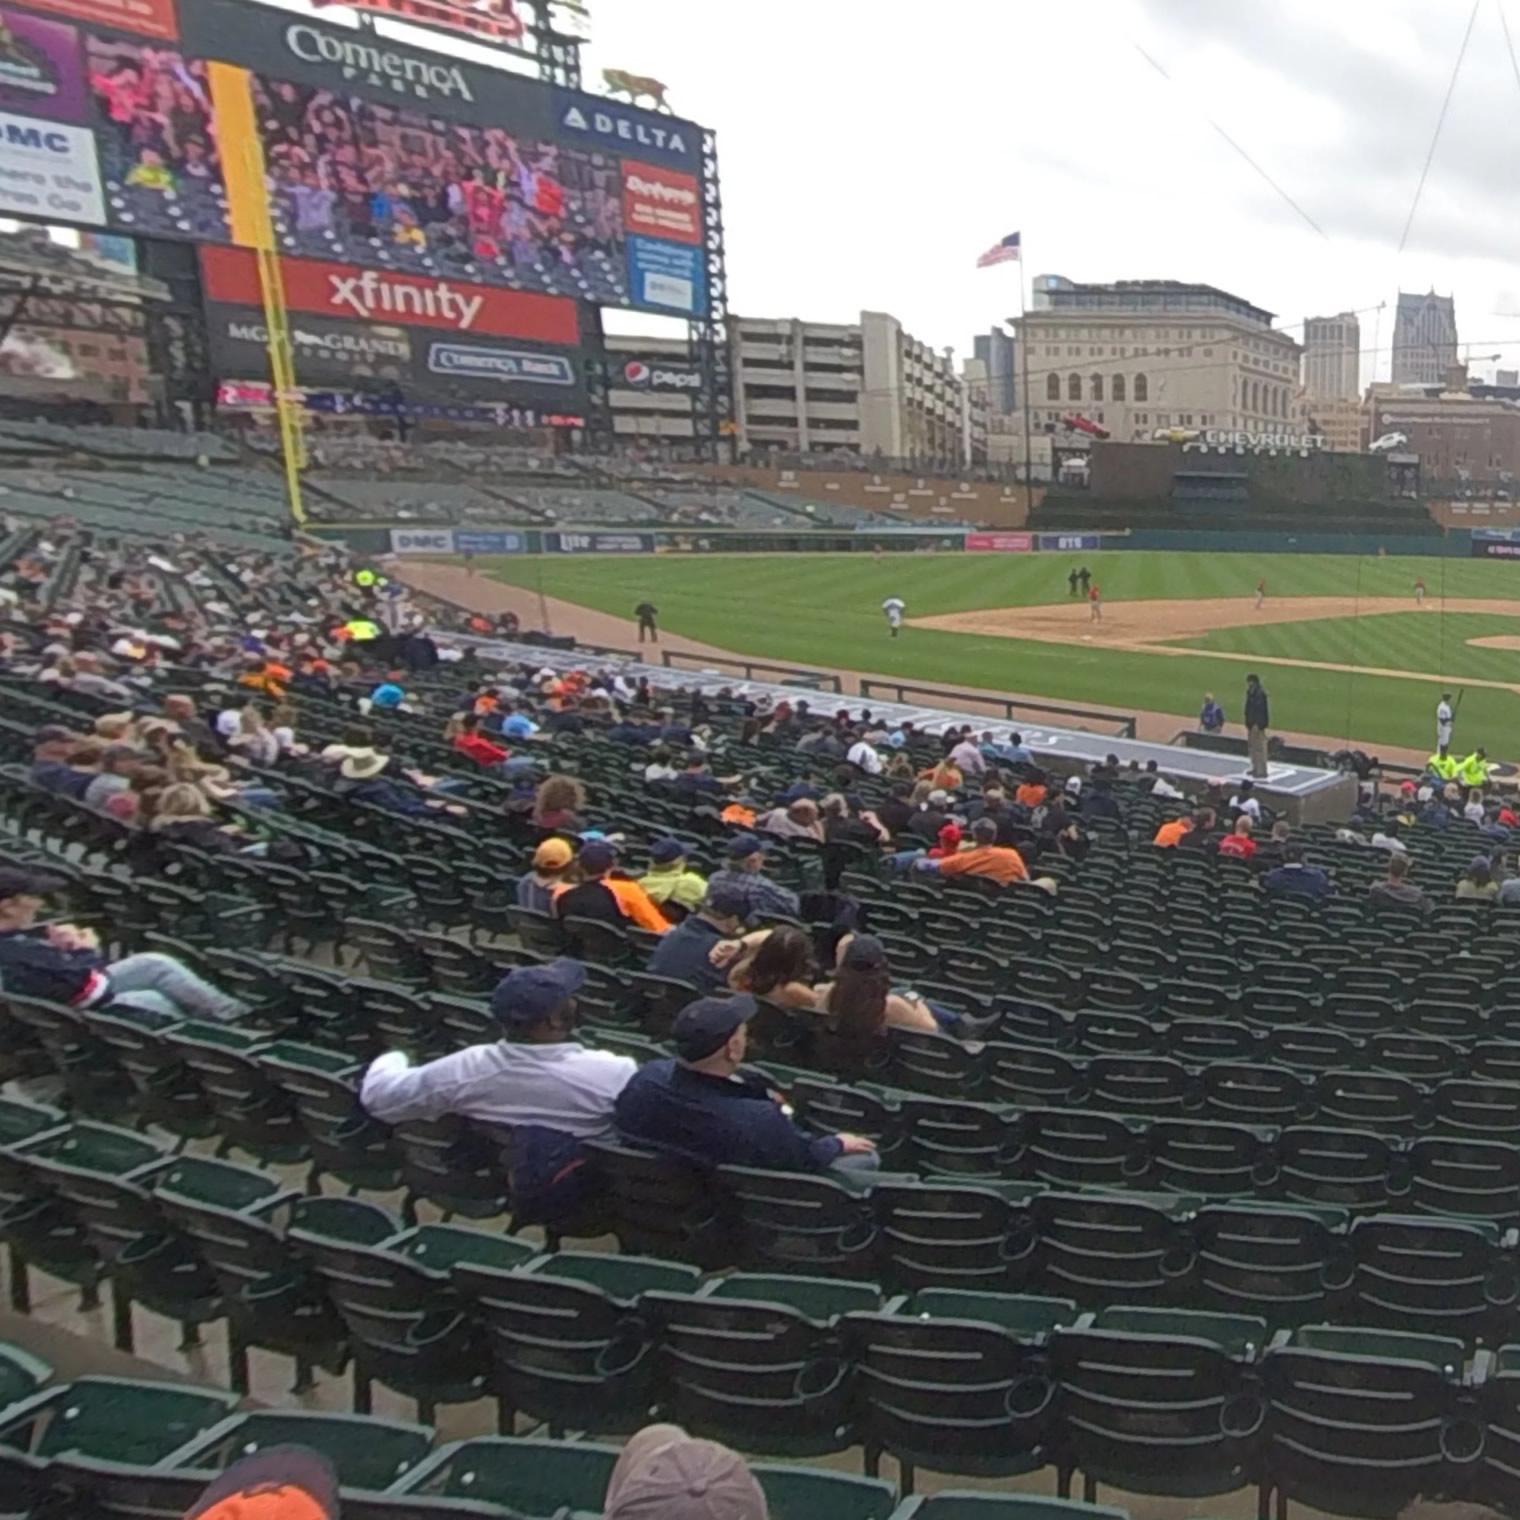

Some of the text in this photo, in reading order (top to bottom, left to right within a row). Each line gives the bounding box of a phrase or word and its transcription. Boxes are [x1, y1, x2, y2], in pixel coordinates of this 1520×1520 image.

[0, 123, 70, 154] MC
[594, 112, 687, 154] DELTA
[328, 271, 484, 329] xfinity
[652, 370, 702, 388] pepsi
[1205, 430, 1325, 449] CHEVROLET
